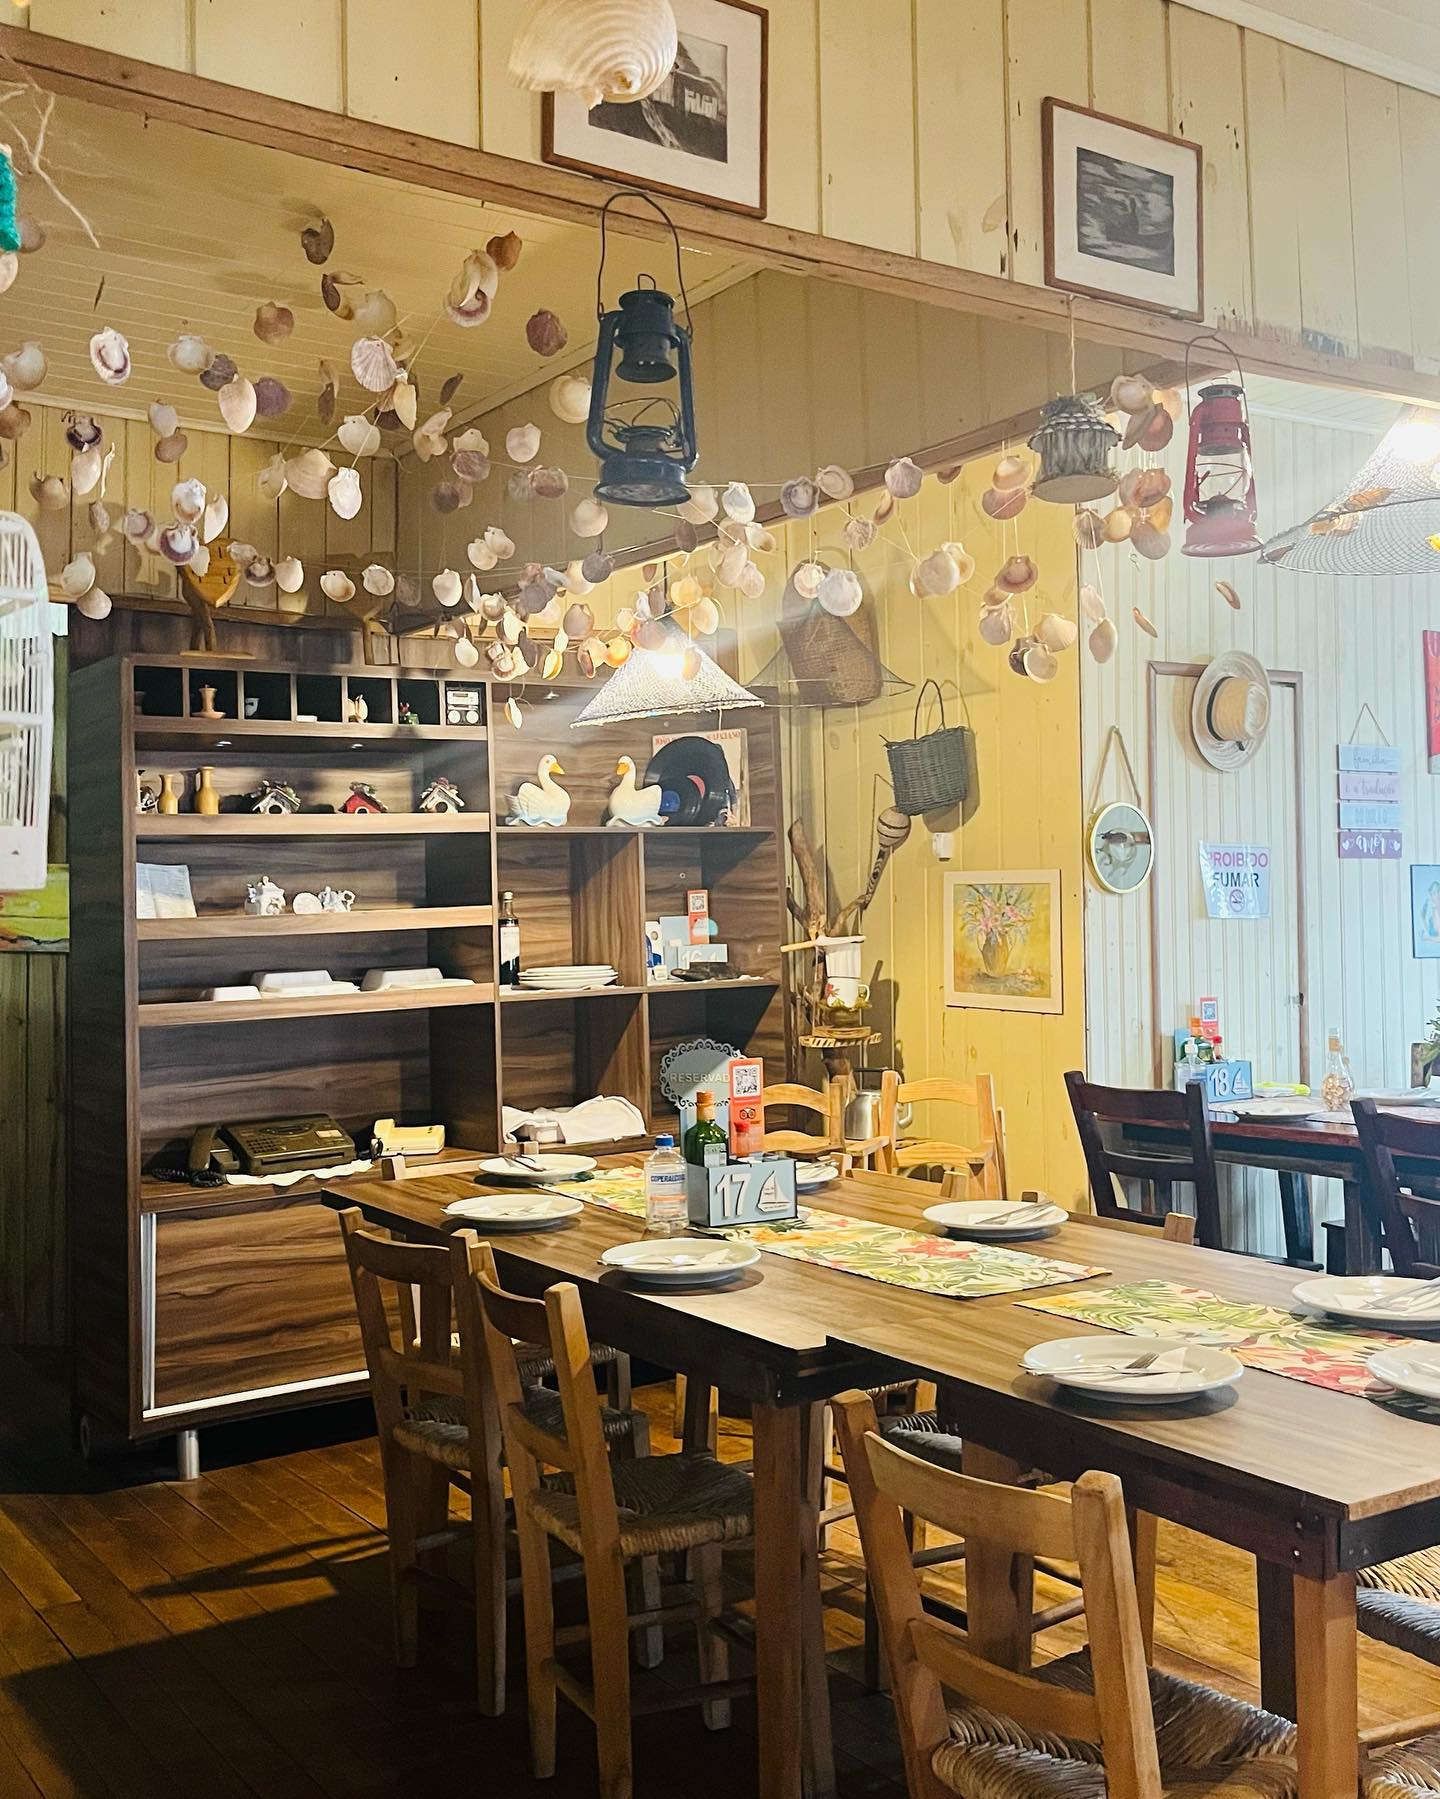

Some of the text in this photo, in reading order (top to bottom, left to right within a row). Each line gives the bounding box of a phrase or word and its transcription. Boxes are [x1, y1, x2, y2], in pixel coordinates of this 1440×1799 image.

[1212, 871, 1260, 888] FUMAR
[669, 1072, 730, 1084] RESERVAD
[1210, 1068, 1231, 1097] 18
[715, 1172, 752, 1219] 17
